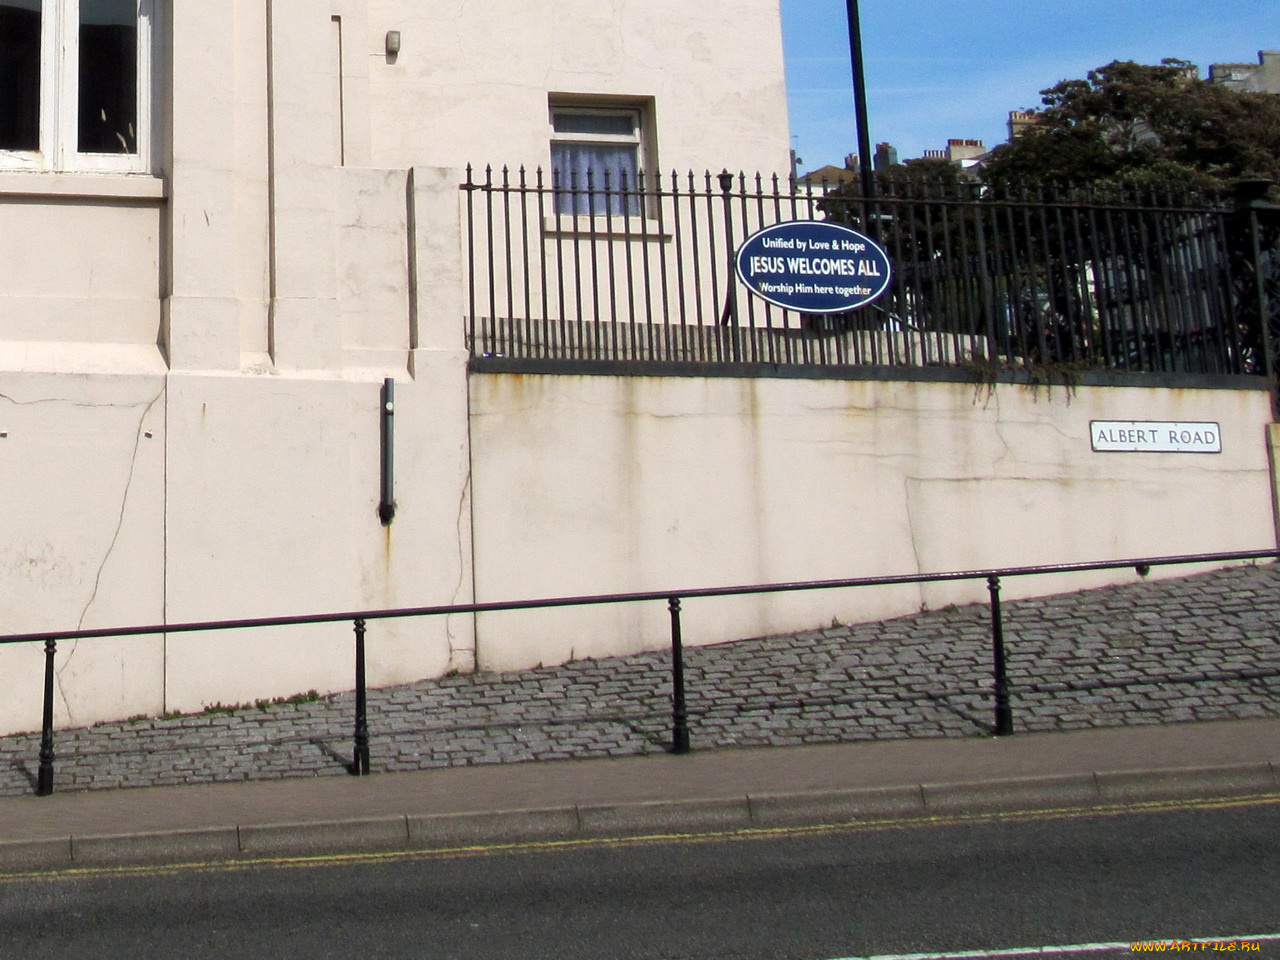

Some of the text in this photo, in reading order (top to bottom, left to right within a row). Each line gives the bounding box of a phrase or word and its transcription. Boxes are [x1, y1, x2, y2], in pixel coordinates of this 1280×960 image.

[762, 237, 866, 254] Unified by Love & Hope
[750, 256, 881, 276] JESUS WELCOMES ALL
[759, 282, 872, 298] Worship Him here together
[1098, 429, 1216, 444] ALBERT ROAD
